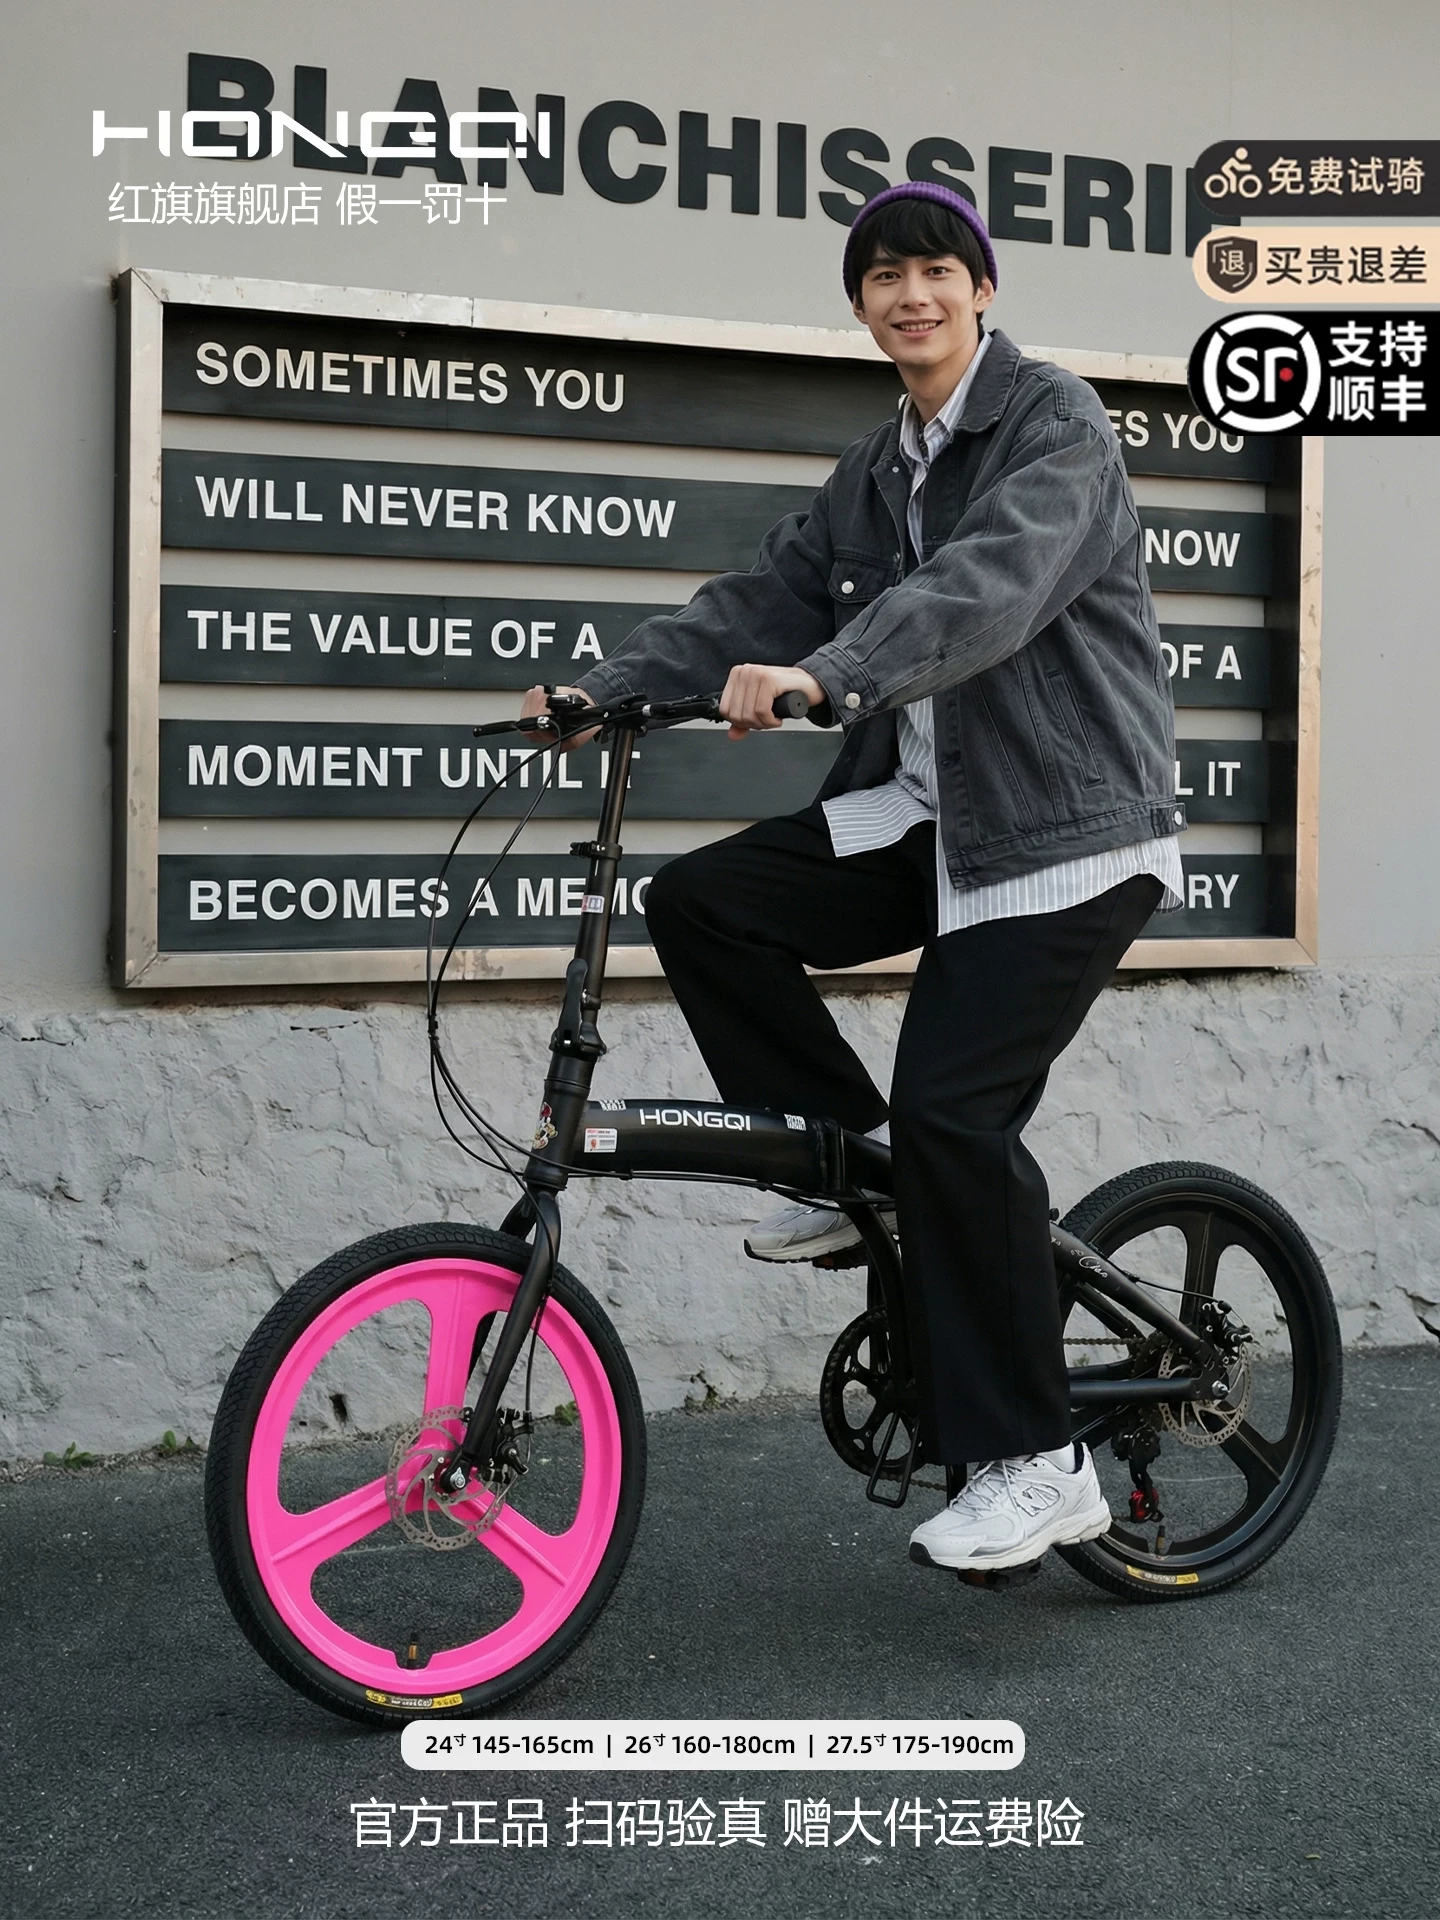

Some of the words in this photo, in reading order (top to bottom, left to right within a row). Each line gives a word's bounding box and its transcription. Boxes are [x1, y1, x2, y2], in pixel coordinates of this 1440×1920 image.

[196, 342, 508, 404] SOMETIMES
[524, 367, 624, 413] YOU
[195, 475, 323, 522] WILL
[342, 483, 509, 531] NEVER
[528, 493, 677, 538] KNOW
[187, 610, 292, 652] THE
[308, 613, 473, 657] VALUE
[491, 619, 556, 659] OF
[571, 622, 604, 660] A
[1215, 645, 1242, 680] A
[188, 744, 423, 787] MOMENT
[439, 748, 583, 788] UNTIL
[1208, 761, 1241, 796] IT
[189, 877, 449, 921] BECOMES
[468, 877, 500, 917] A
[639, 1108, 751, 1131] HONGQI
